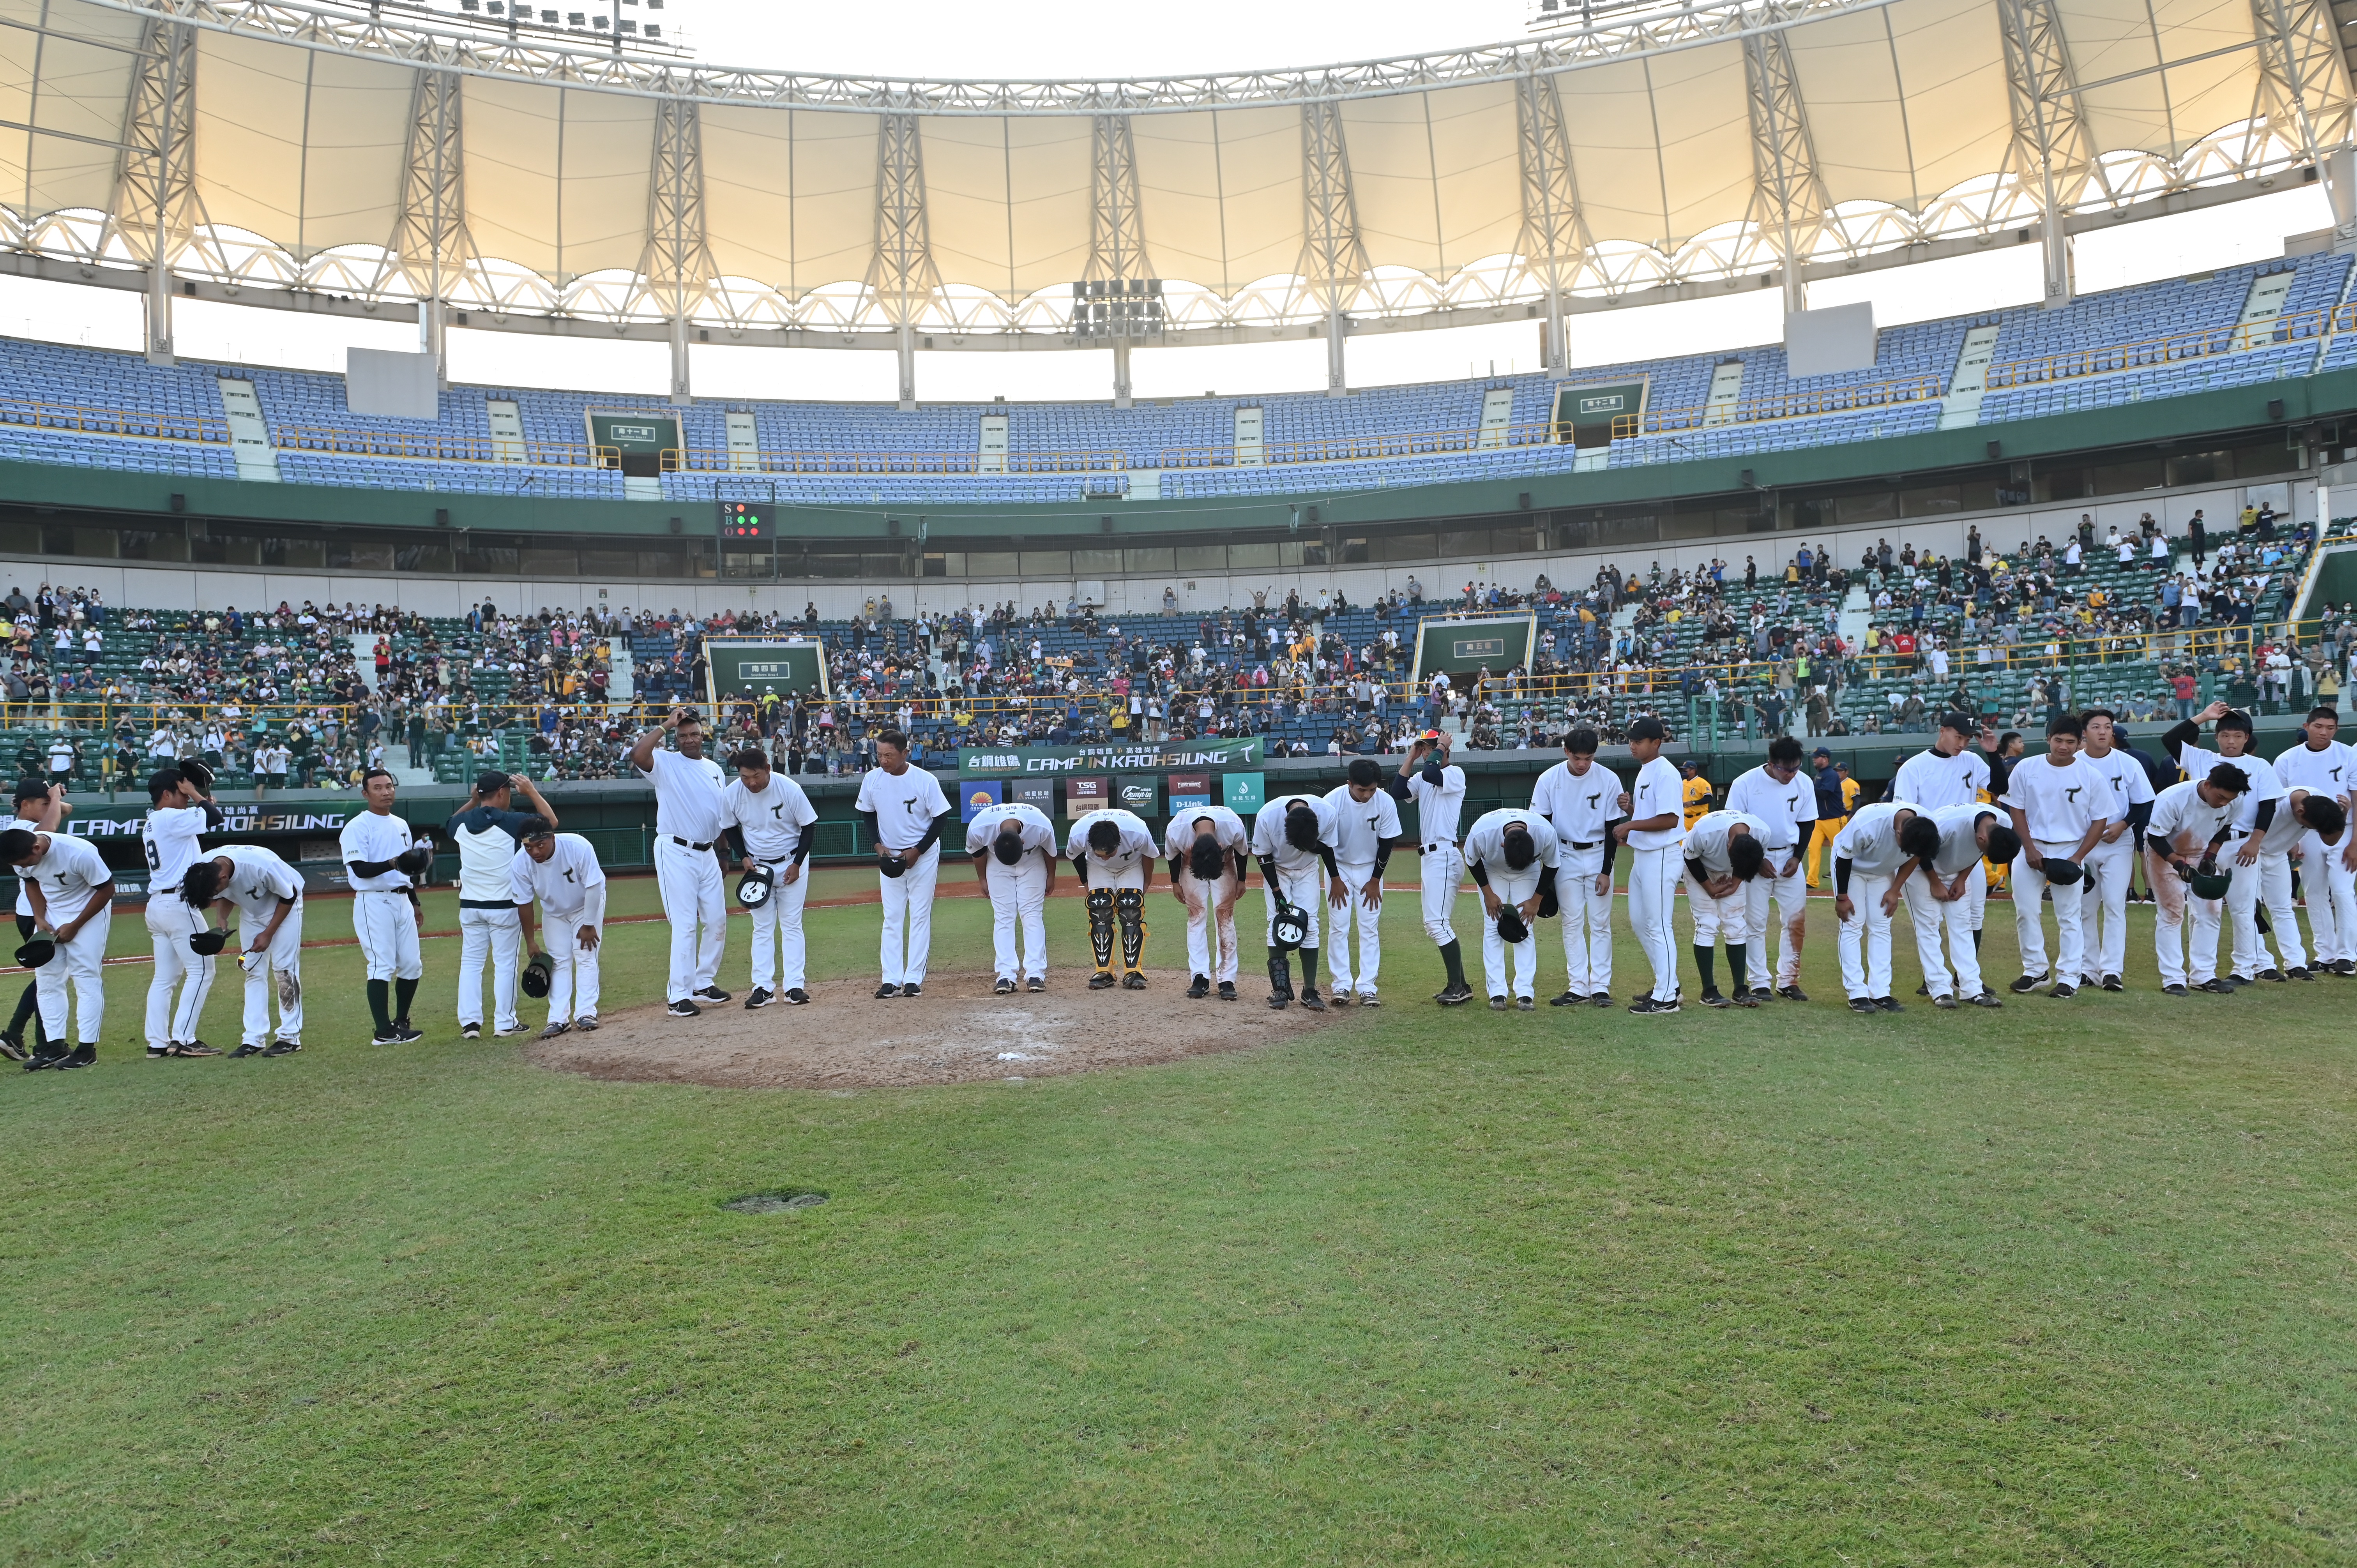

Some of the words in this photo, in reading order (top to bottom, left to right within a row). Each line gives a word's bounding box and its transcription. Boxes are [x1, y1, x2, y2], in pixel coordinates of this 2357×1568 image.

[724, 504, 731, 513] S
[725, 516, 733, 524] B
[725, 527, 733, 536] O
[1079, 748, 1113, 756] 台鋼雄鷹
[1126, 746, 1161, 754] 高雄尚贏
[968, 755, 1020, 767] 台鋼雄鷹
[1026, 757, 1083, 771] CAMP
[1087, 756, 1107, 769] IN
[1111, 751, 1228, 768] KAOHSIUNG
[1122, 786, 1145, 800] Camp
[206, 814, 346, 833] AOHSIUNG
